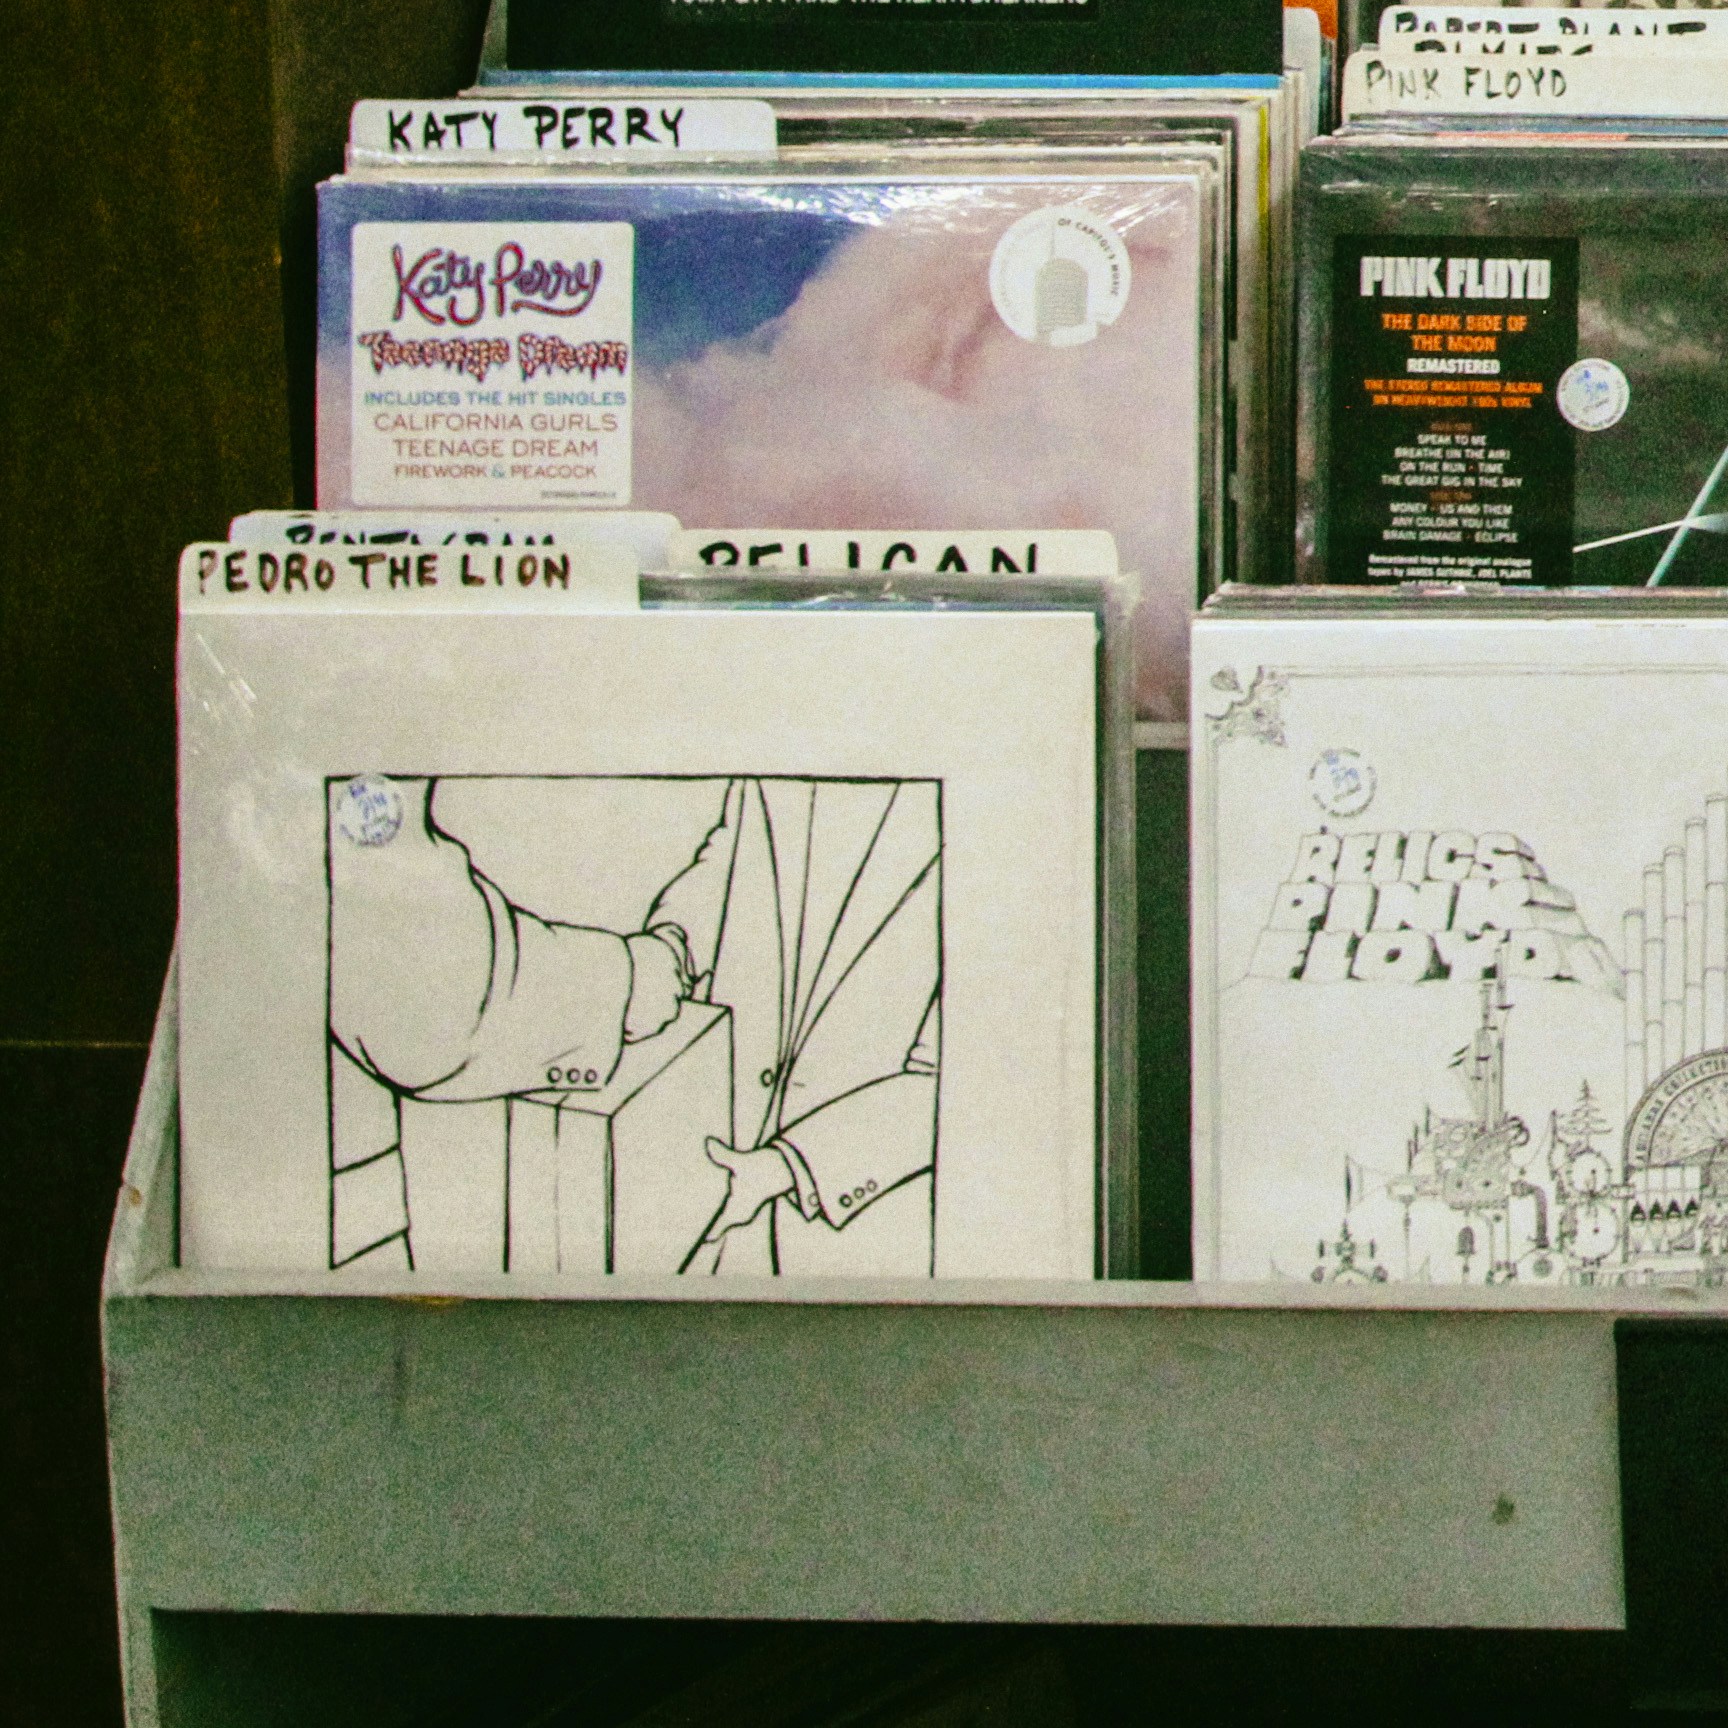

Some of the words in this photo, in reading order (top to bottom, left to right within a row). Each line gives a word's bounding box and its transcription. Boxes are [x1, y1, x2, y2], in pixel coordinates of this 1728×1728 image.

[1366, 60, 1441, 103] PINK
[1464, 66, 1568, 98] FLOYD
[387, 109, 500, 152] KATY
[523, 105, 686, 150] PERRY
[393, 243, 486, 326] Katy
[490, 241, 603, 316] Perry
[1360, 256, 1444, 299] PINK
[1446, 257, 1550, 299] FLOYD
[1382, 313, 1412, 330] THE
[1417, 314, 1462, 331] DARK
[1466, 315, 1502, 332] SIDE
[1507, 316, 1527, 332] OF
[1411, 334, 1443, 352] THE
[1446, 335, 1497, 352] MOON
[1406, 358, 1500, 374] REMASTERED
[364, 391, 460, 406] INCLUDES
[467, 391, 501, 406] THE
[508, 391, 537, 405] HIT
[543, 391, 626, 405] SINGLES
[374, 413, 523, 431] CALIFORNIA
[531, 413, 618, 431] GURLS
[393, 439, 503, 457] TEENAGE
[512, 439, 598, 457] DREAM
[394, 465, 487, 478] FIREWORK
[509, 465, 596, 479] PEACOCK
[199, 550, 336, 595] PEDRO
[349, 553, 438, 590] THE
[461, 553, 570, 590] LION
